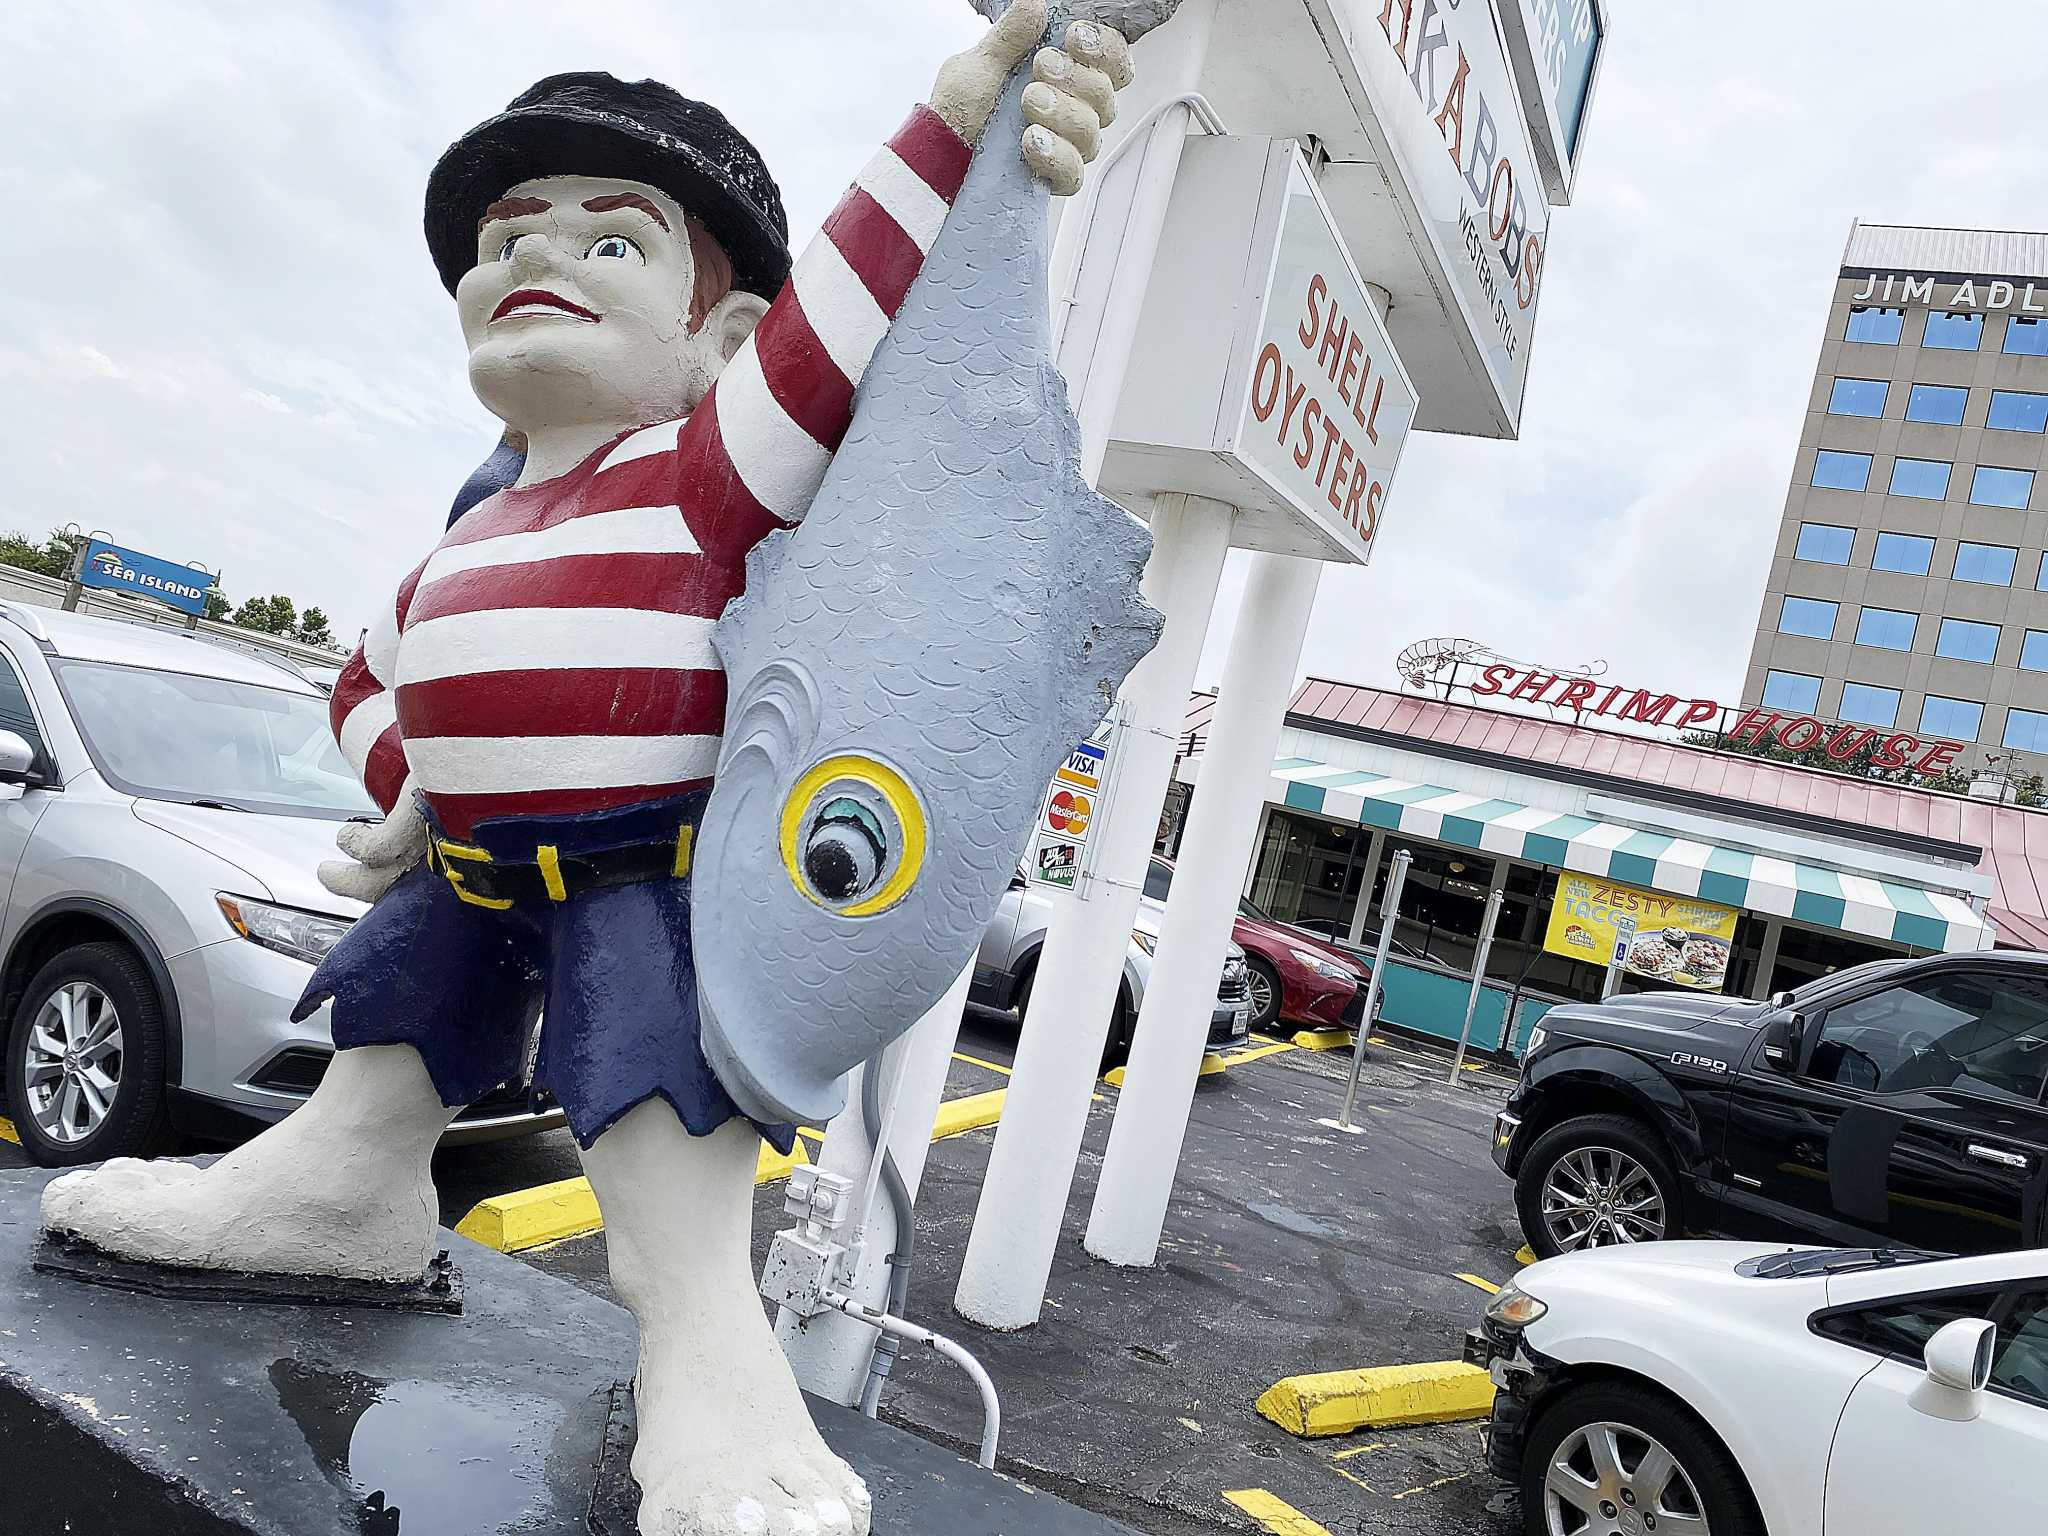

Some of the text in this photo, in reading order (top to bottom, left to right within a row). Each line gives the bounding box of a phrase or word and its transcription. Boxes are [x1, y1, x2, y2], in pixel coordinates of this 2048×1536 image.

[1457, 196, 1517, 361] WESTERN STYLE
[1853, 273, 2045, 311] JIM ADL
[1298, 273, 1385, 446] SHELL
[1251, 342, 1383, 541] OYSTERS
[102, 563, 202, 599] SEA ISLAND
[1471, 663, 1966, 776] SHRIMP HOUSE
[1067, 752, 1096, 776] VISA
[1049, 803, 1089, 824] MasterCard
[1592, 883, 1676, 918] ZESTY
